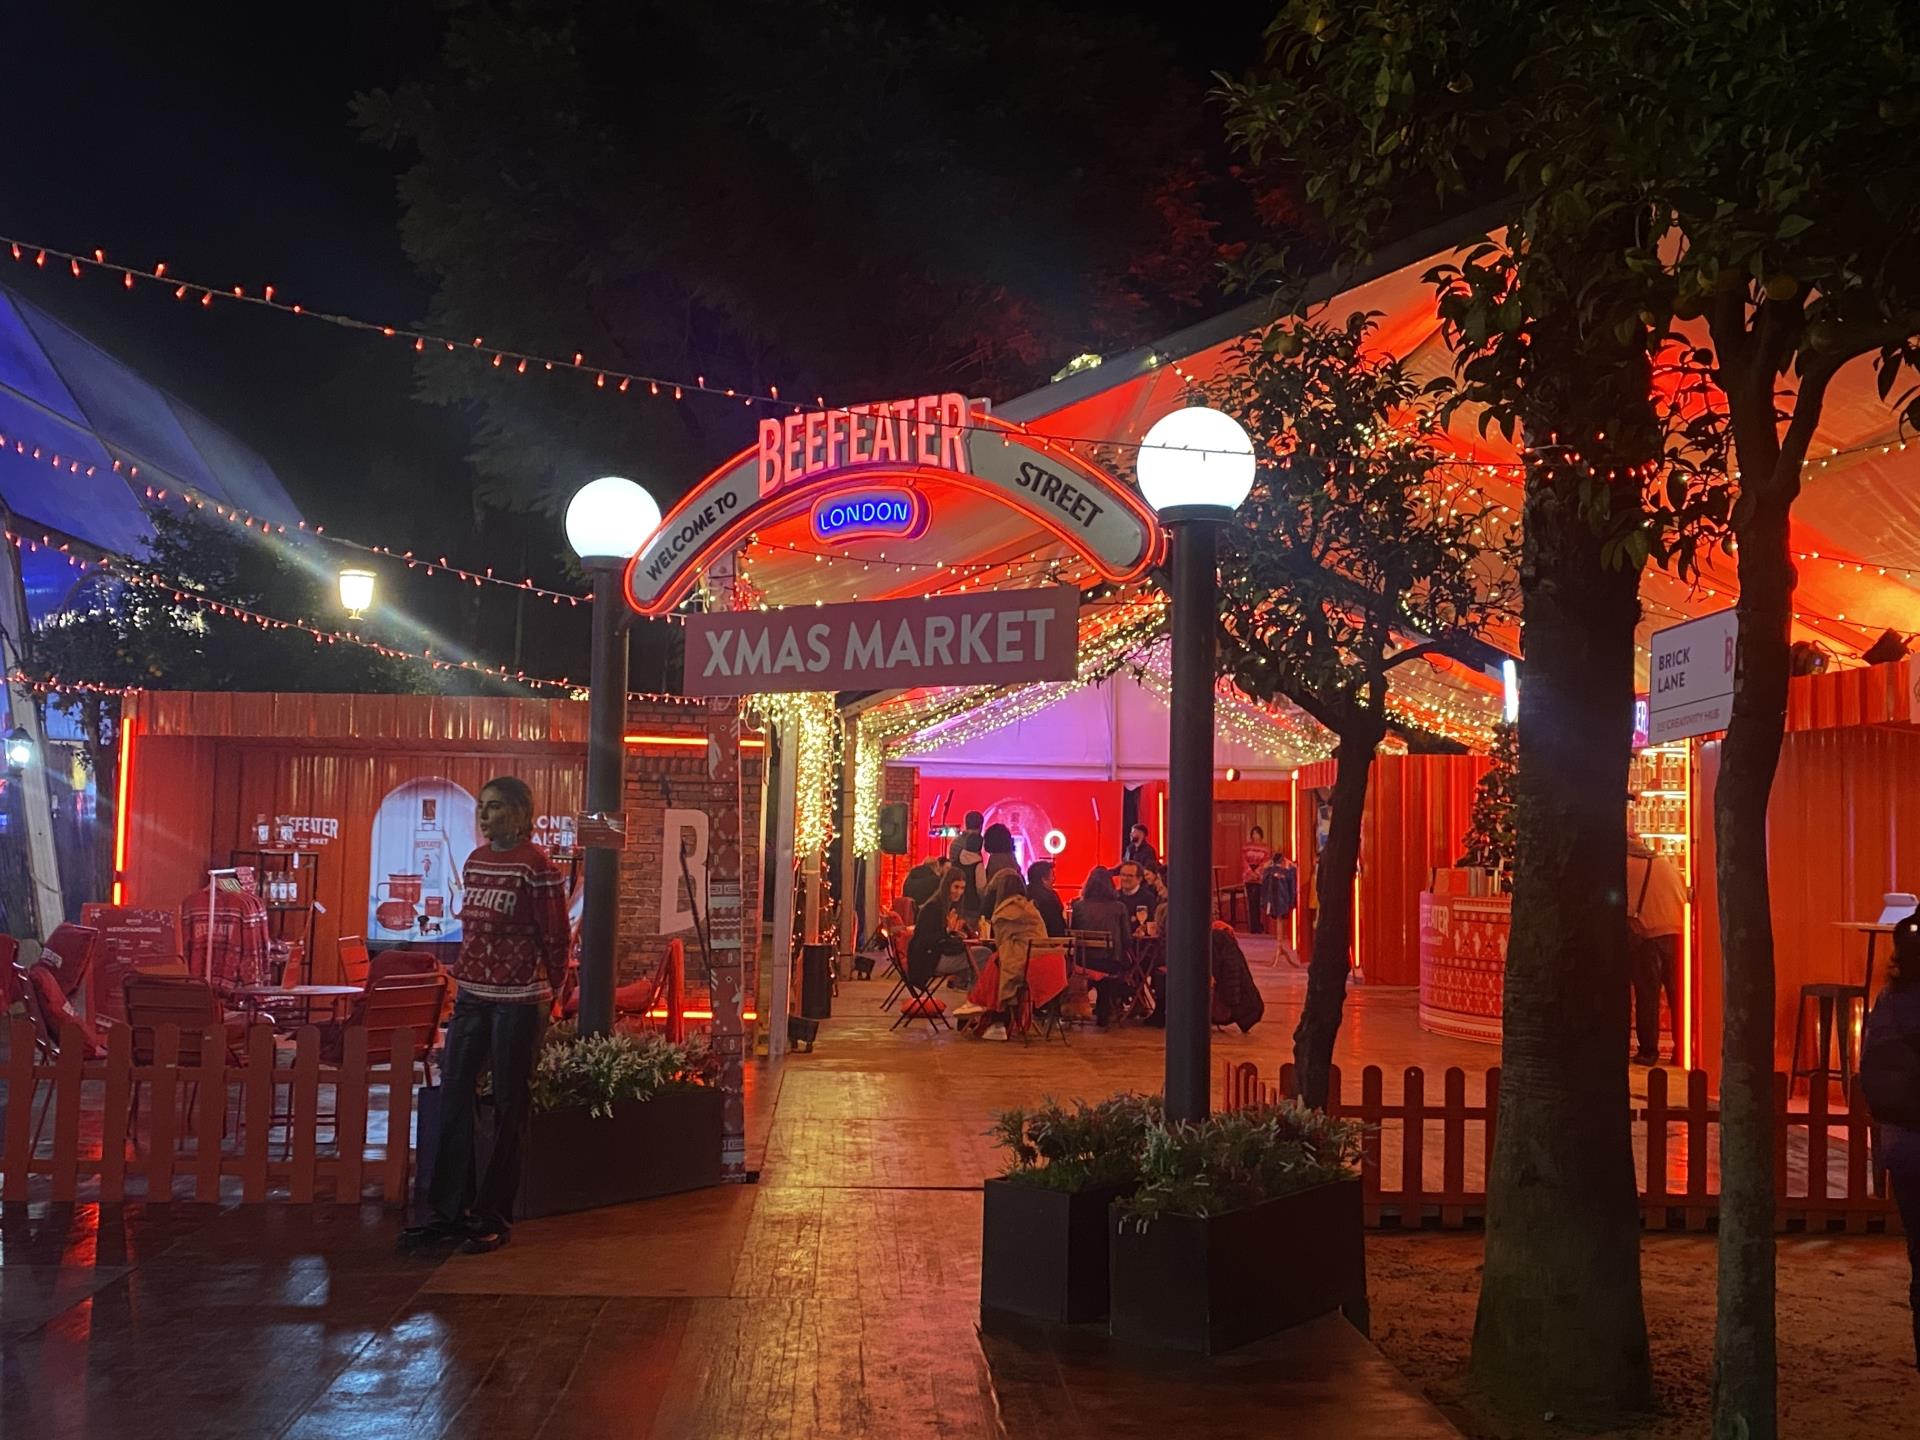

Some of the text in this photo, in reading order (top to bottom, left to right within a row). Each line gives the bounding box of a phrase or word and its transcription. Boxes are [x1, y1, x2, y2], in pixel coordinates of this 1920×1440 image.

[758, 392, 967, 498] BEEFEATER
[819, 501, 909, 531] LONDON
[1015, 460, 1104, 528] STREET
[646, 490, 739, 582] WELCOME TO
[702, 608, 1056, 678] XMAS MARKET
[1658, 646, 1691, 672] BRICK
[1657, 671, 1686, 694] LANE
[659, 808, 712, 936] B
